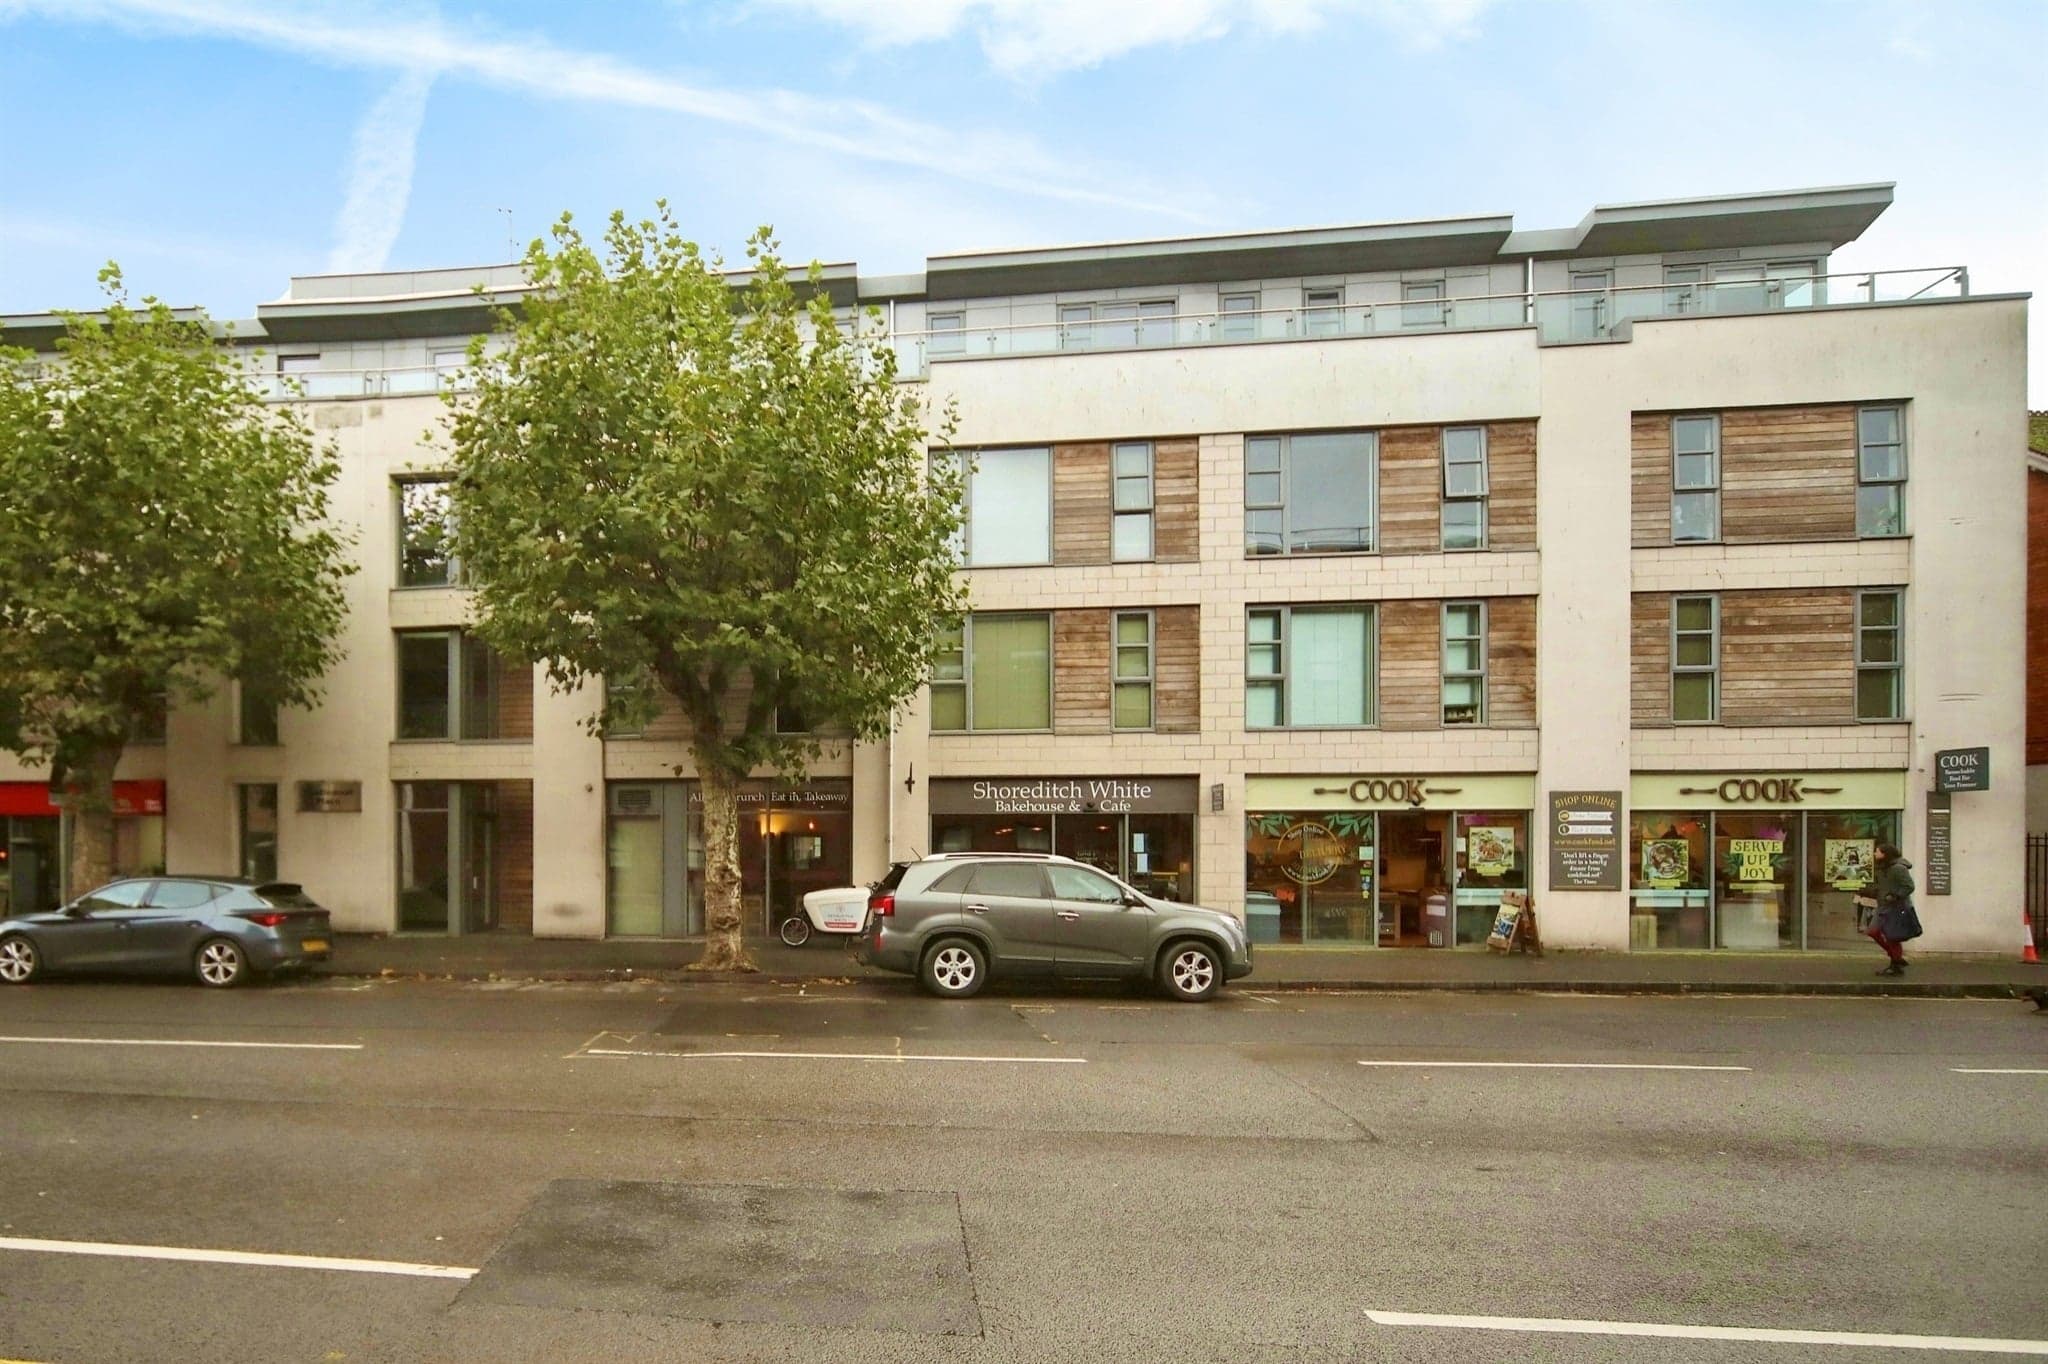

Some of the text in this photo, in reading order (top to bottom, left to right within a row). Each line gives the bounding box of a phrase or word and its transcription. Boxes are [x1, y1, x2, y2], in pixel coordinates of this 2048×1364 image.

[1940, 754, 1978, 768] COOK
[973, 780, 1152, 799] Shoreditch White
[1349, 779, 1427, 803] COOK
[1719, 779, 1804, 803] COOK
[736, 791, 765, 802] runch
[771, 791, 786, 801] Eat
[805, 791, 848, 804] Takeaway
[1555, 795, 1616, 808] SHOP ONLINE
[995, 800, 1131, 812] Bakehouse & Cafe
[1734, 841, 1780, 852] SERVE
[1747, 854, 1767, 865] UP
[1743, 867, 1769, 879] JOY
